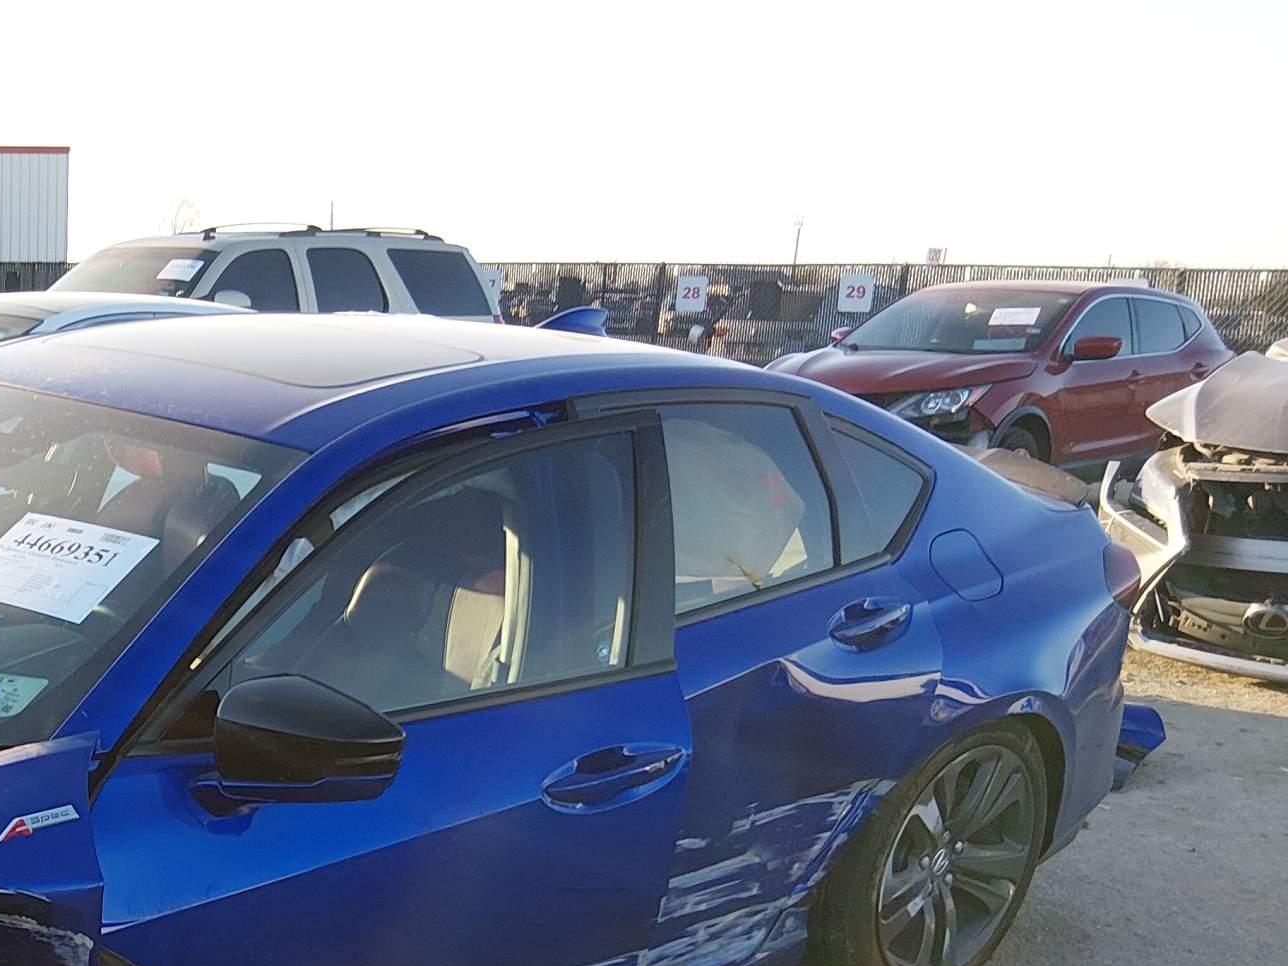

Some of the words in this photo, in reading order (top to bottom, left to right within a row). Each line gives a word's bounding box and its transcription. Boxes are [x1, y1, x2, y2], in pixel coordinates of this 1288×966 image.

[682, 286, 701, 300] 28
[845, 285, 866, 299] 29
[13, 532, 120, 567] 44669351
